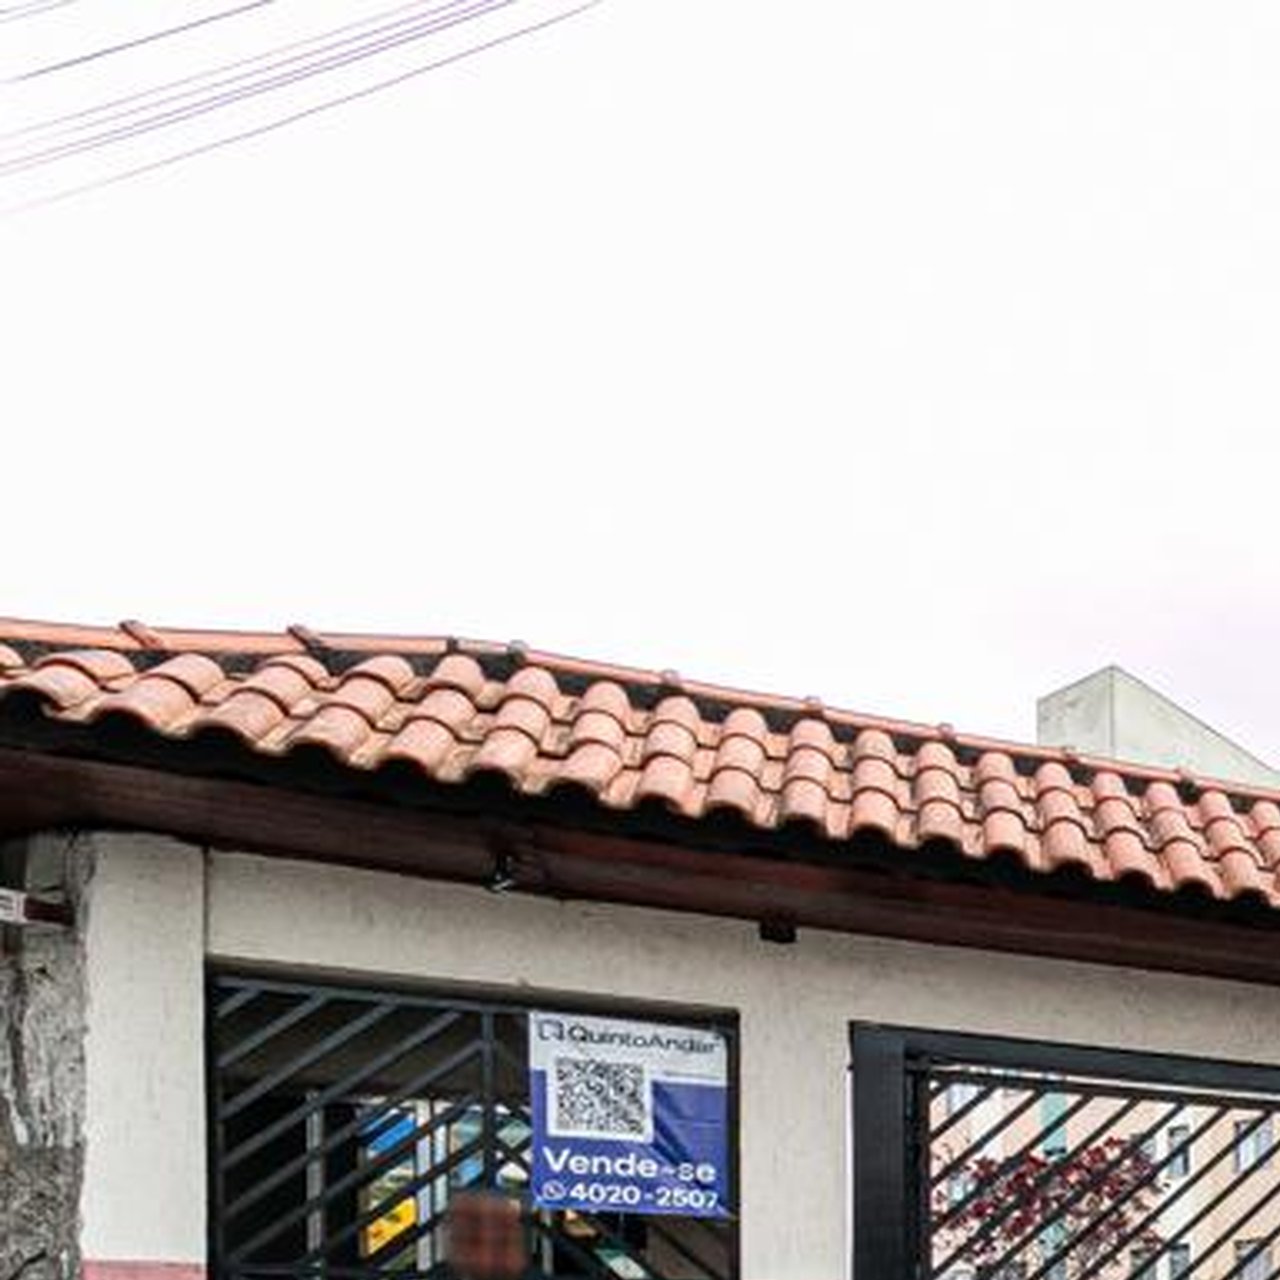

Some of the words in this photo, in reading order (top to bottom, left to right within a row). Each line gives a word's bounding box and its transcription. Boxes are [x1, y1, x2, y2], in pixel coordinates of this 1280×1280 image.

[567, 1024, 717, 1054] QuintoAndar
[543, 1147, 716, 1183] Vende-se
[569, 1183, 718, 1208] 4020-2507
